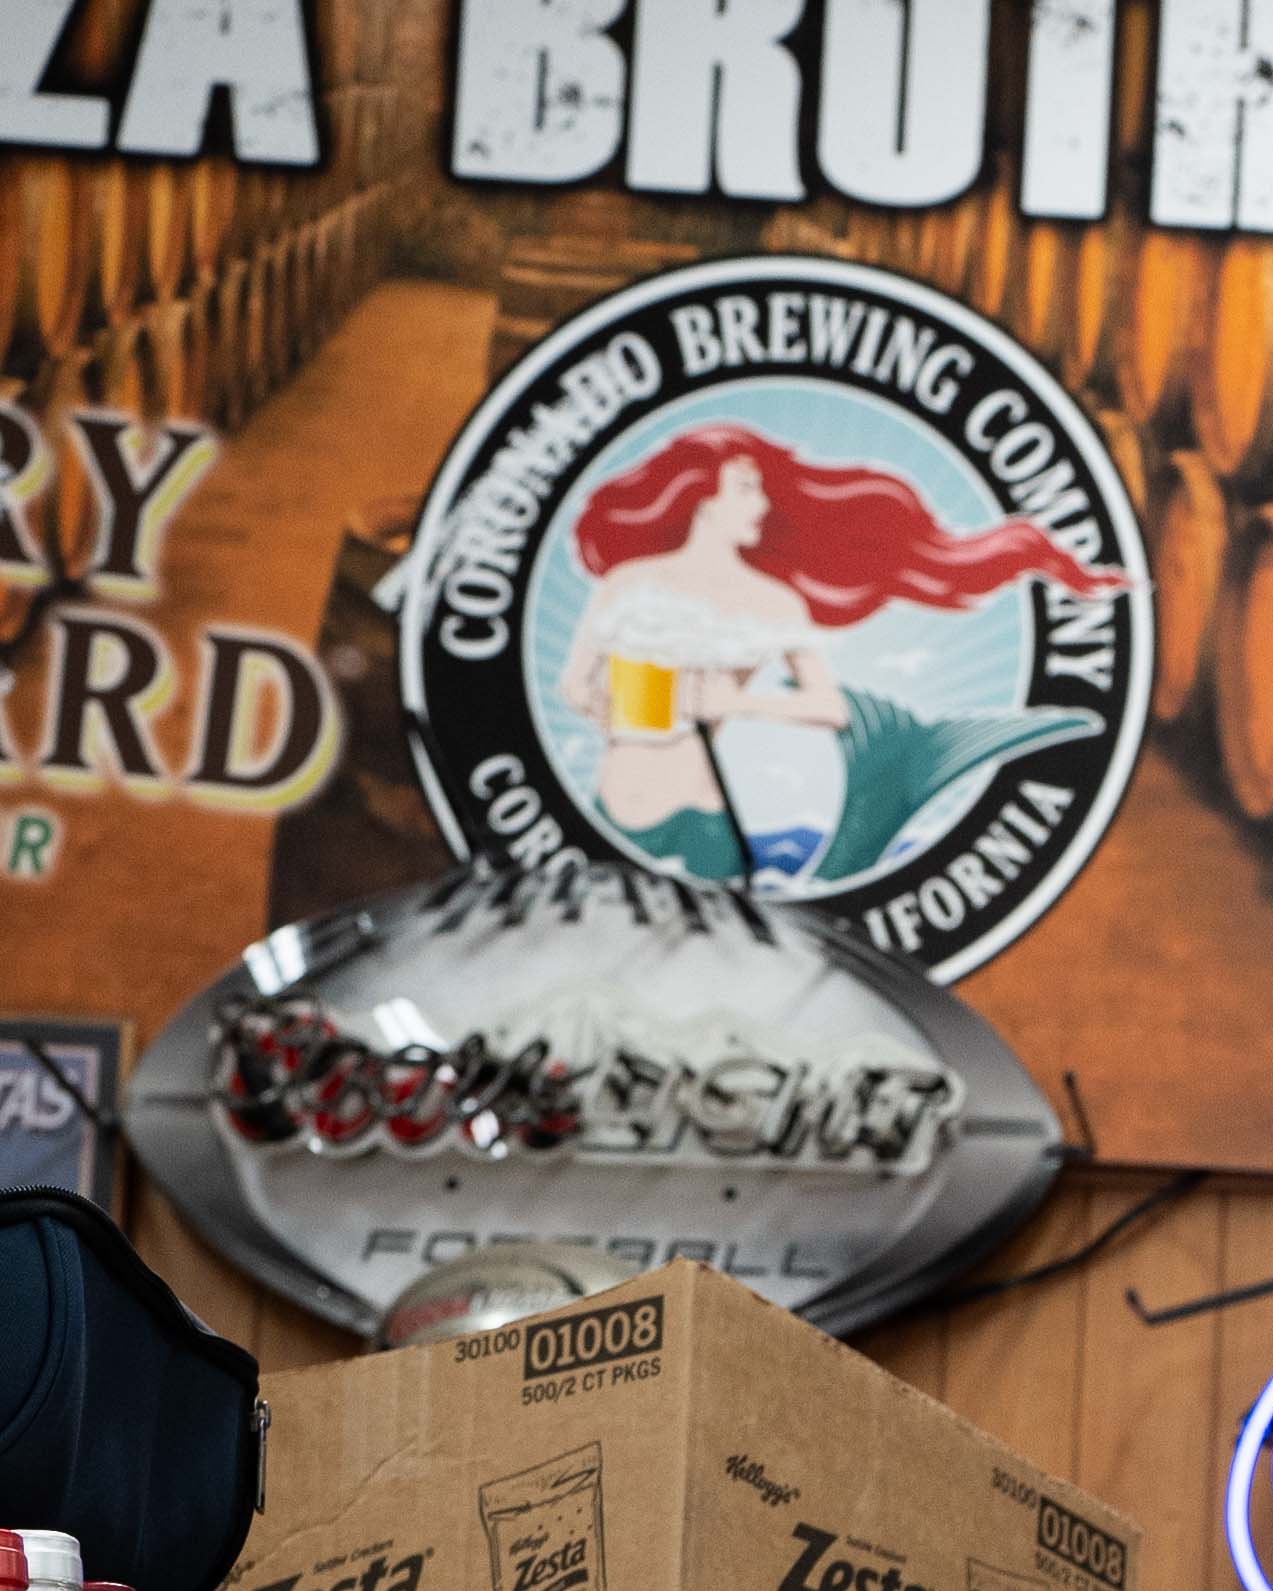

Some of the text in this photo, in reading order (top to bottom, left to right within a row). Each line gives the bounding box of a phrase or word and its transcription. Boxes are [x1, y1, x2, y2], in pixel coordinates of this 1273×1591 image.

[441, 291, 1114, 693] CORONADO BREWING COMPNY
[0, 605, 344, 809] RD
[454, 1305, 658, 1371] 30100 01008
[521, 1356, 662, 1405] 500/2 CT PKGS
[1042, 1505, 1122, 1585] 01008
